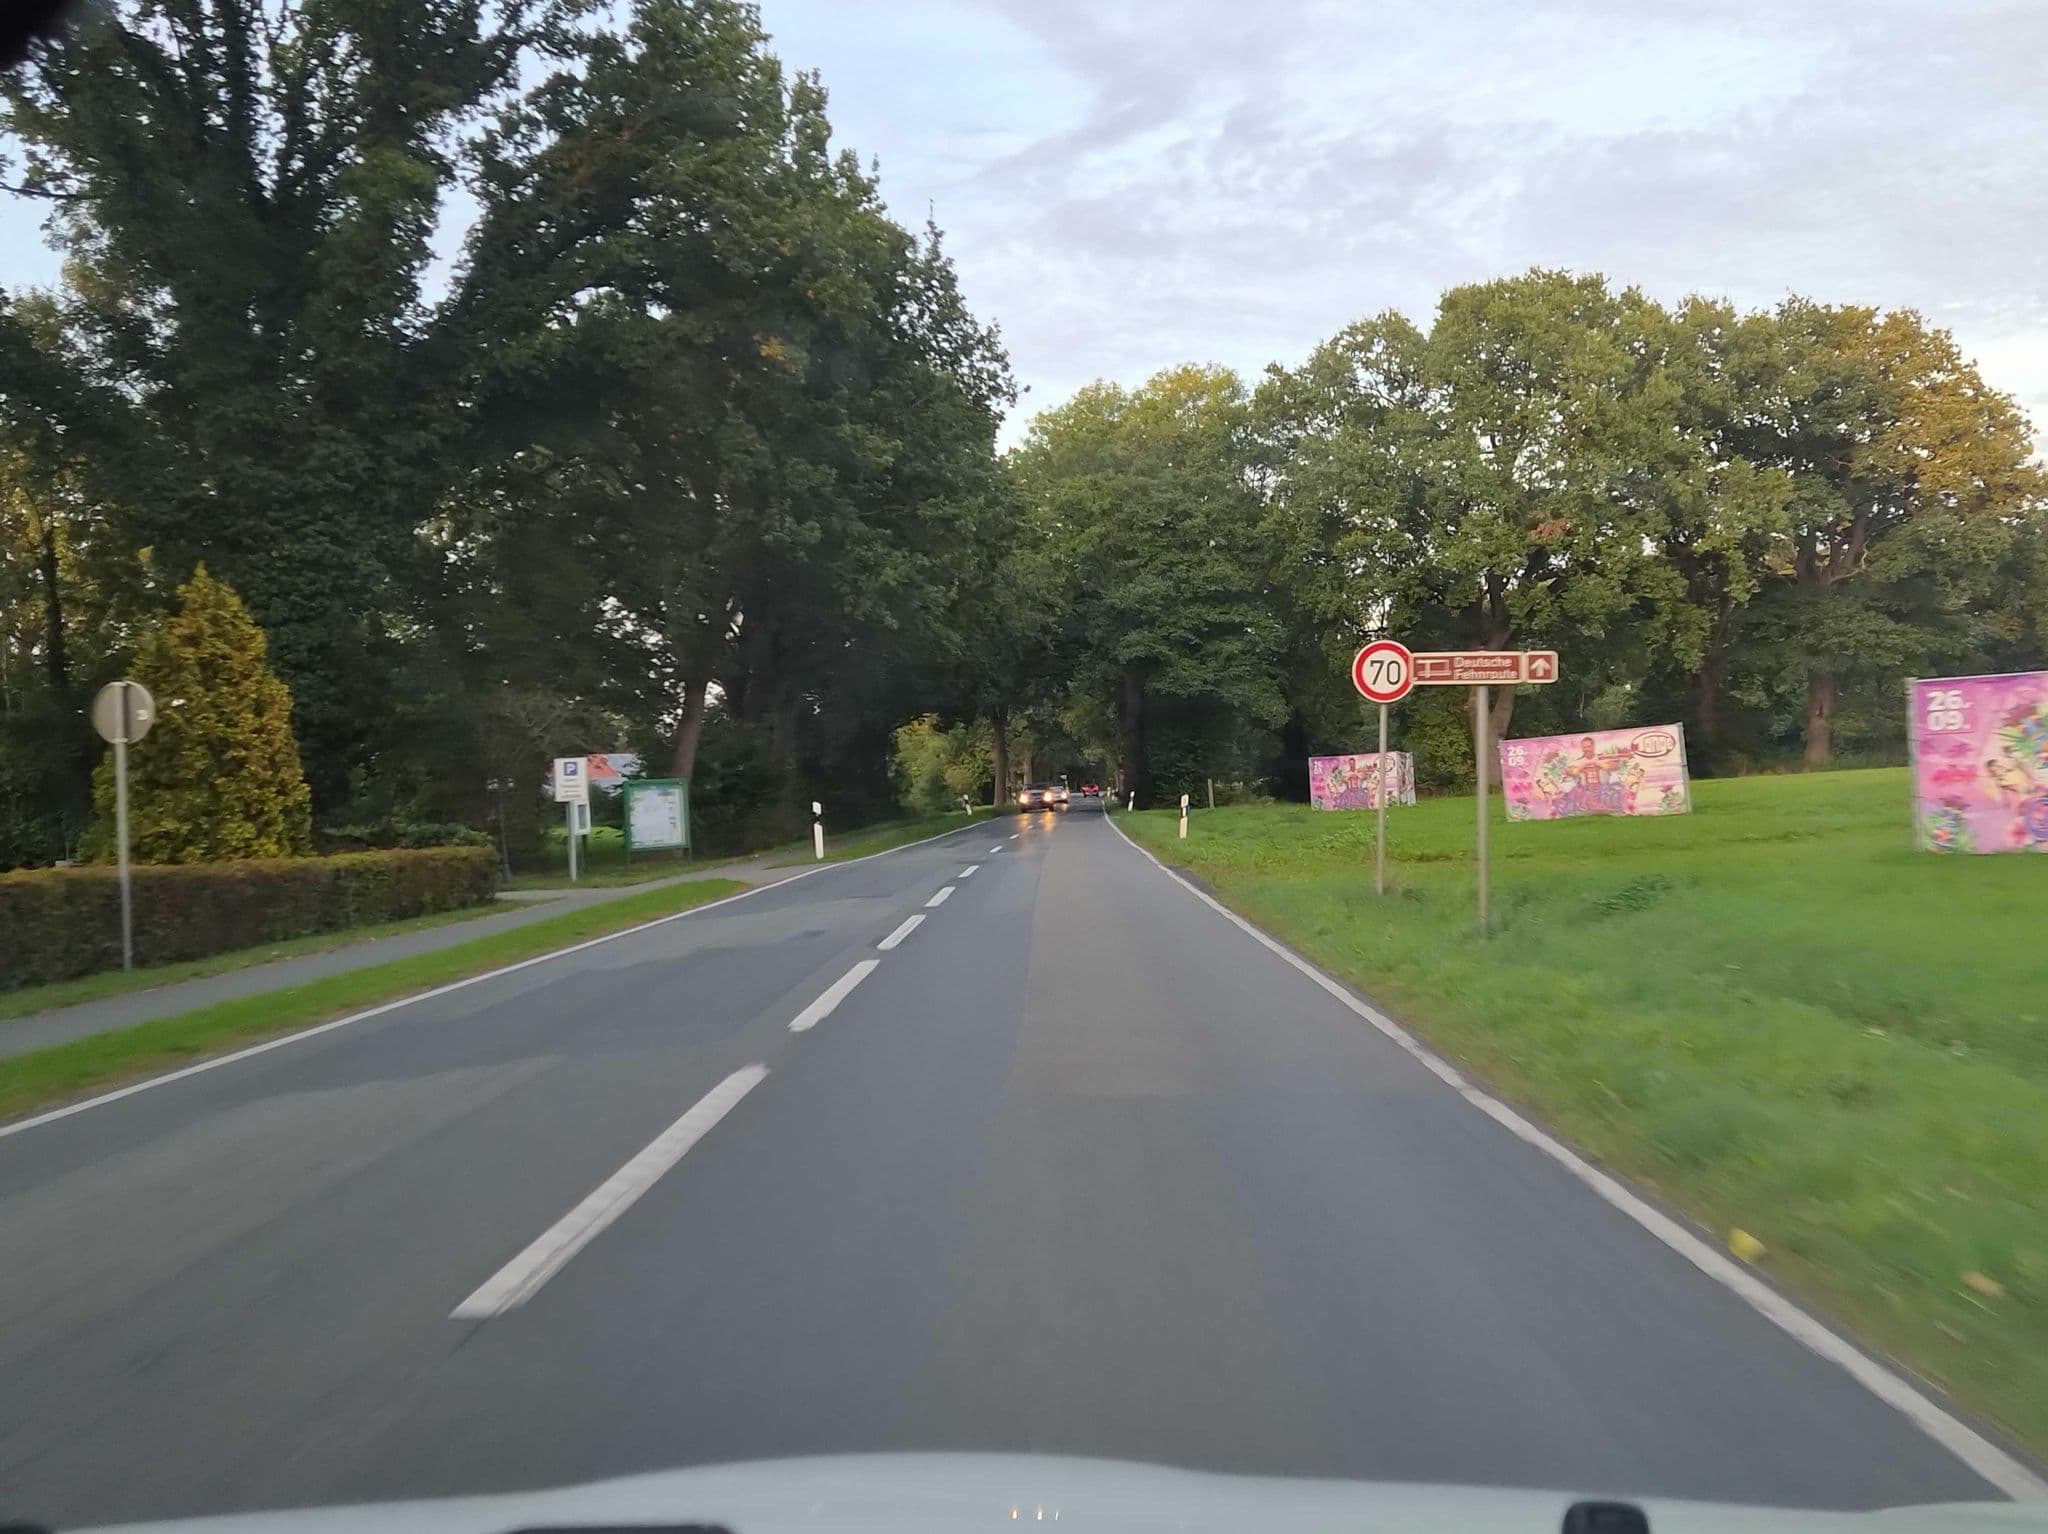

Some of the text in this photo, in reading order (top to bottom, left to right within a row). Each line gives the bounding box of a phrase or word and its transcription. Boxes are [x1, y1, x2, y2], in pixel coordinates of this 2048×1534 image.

[1453, 657, 1512, 668] Deutsche
[1370, 660, 1400, 685] 70
[1453, 669, 1518, 680] Fehnroute
